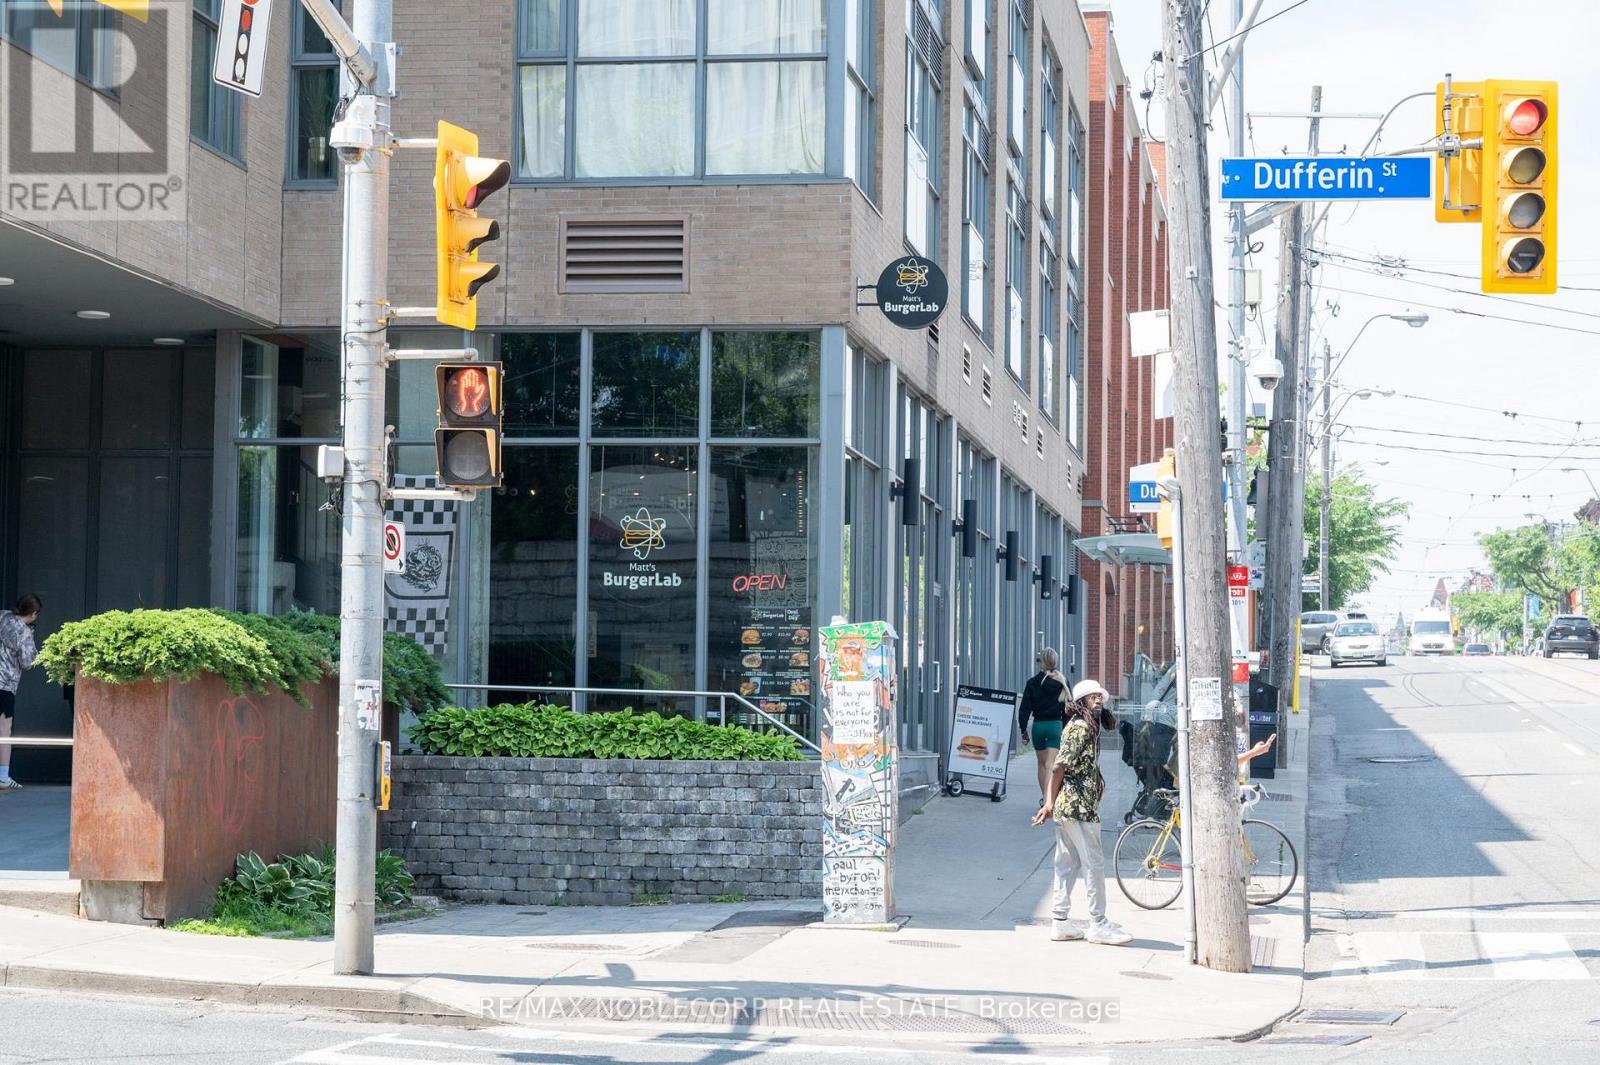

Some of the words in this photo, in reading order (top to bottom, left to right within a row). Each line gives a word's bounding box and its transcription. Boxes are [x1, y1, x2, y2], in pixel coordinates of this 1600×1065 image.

[1254, 161, 1373, 190] Dufferin
[1382, 162, 1398, 177] St
[884, 302, 939, 315] BurgerLab
[629, 563, 656, 571] Matt's
[603, 572, 682, 590] BurgerLab
[732, 574, 787, 592] OPEN
[857, 690, 871, 701] you
[833, 858, 857, 874] paul
